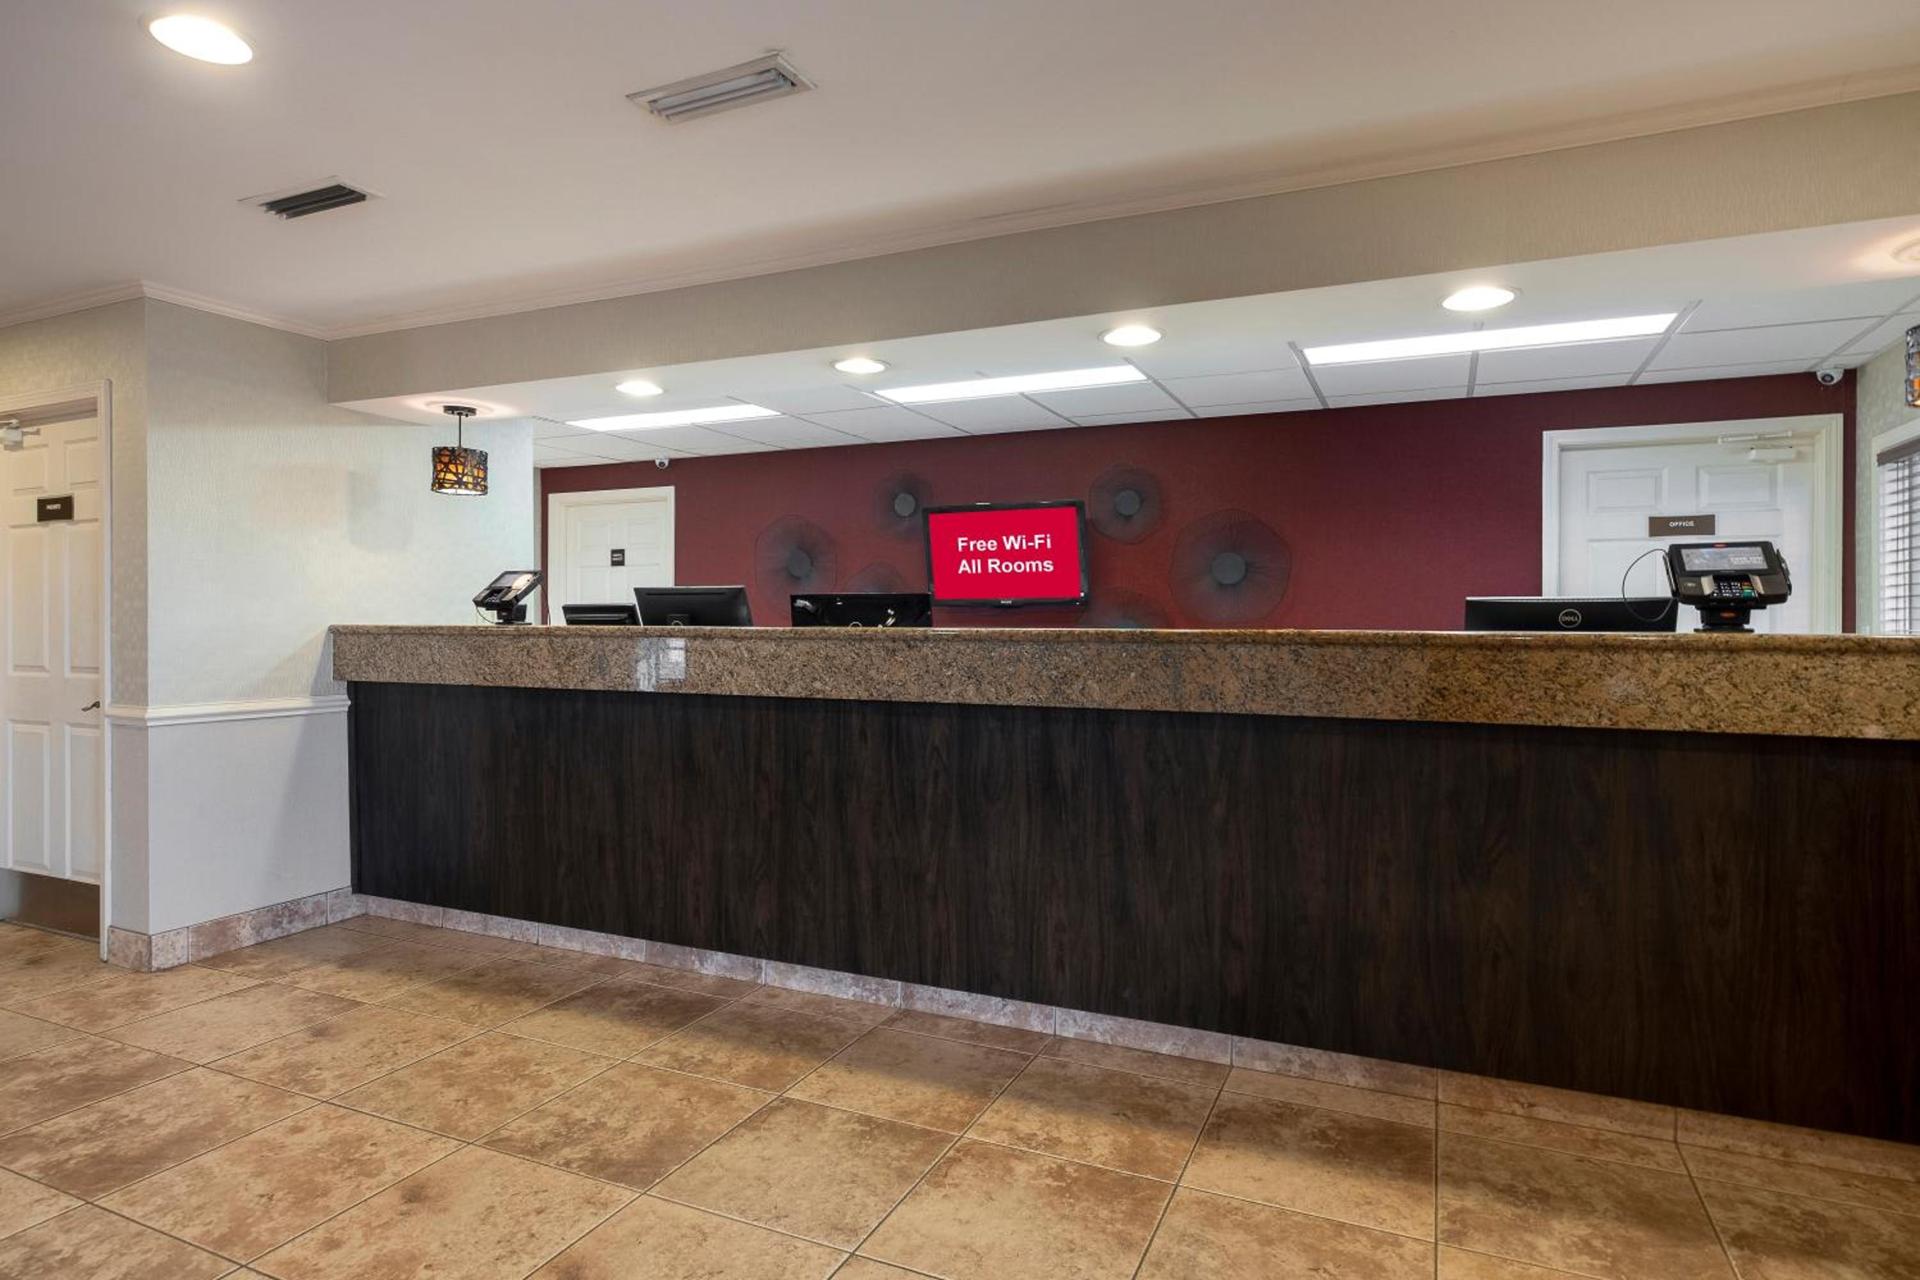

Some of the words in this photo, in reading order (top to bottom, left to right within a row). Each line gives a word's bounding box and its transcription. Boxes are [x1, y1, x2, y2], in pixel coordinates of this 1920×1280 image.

[1669, 520, 1695, 528] OFFICE
[957, 536, 998, 552] Free
[1002, 534, 1052, 551] Wi-Fi
[958, 558, 982, 574] All
[987, 558, 1055, 573] Rooms
